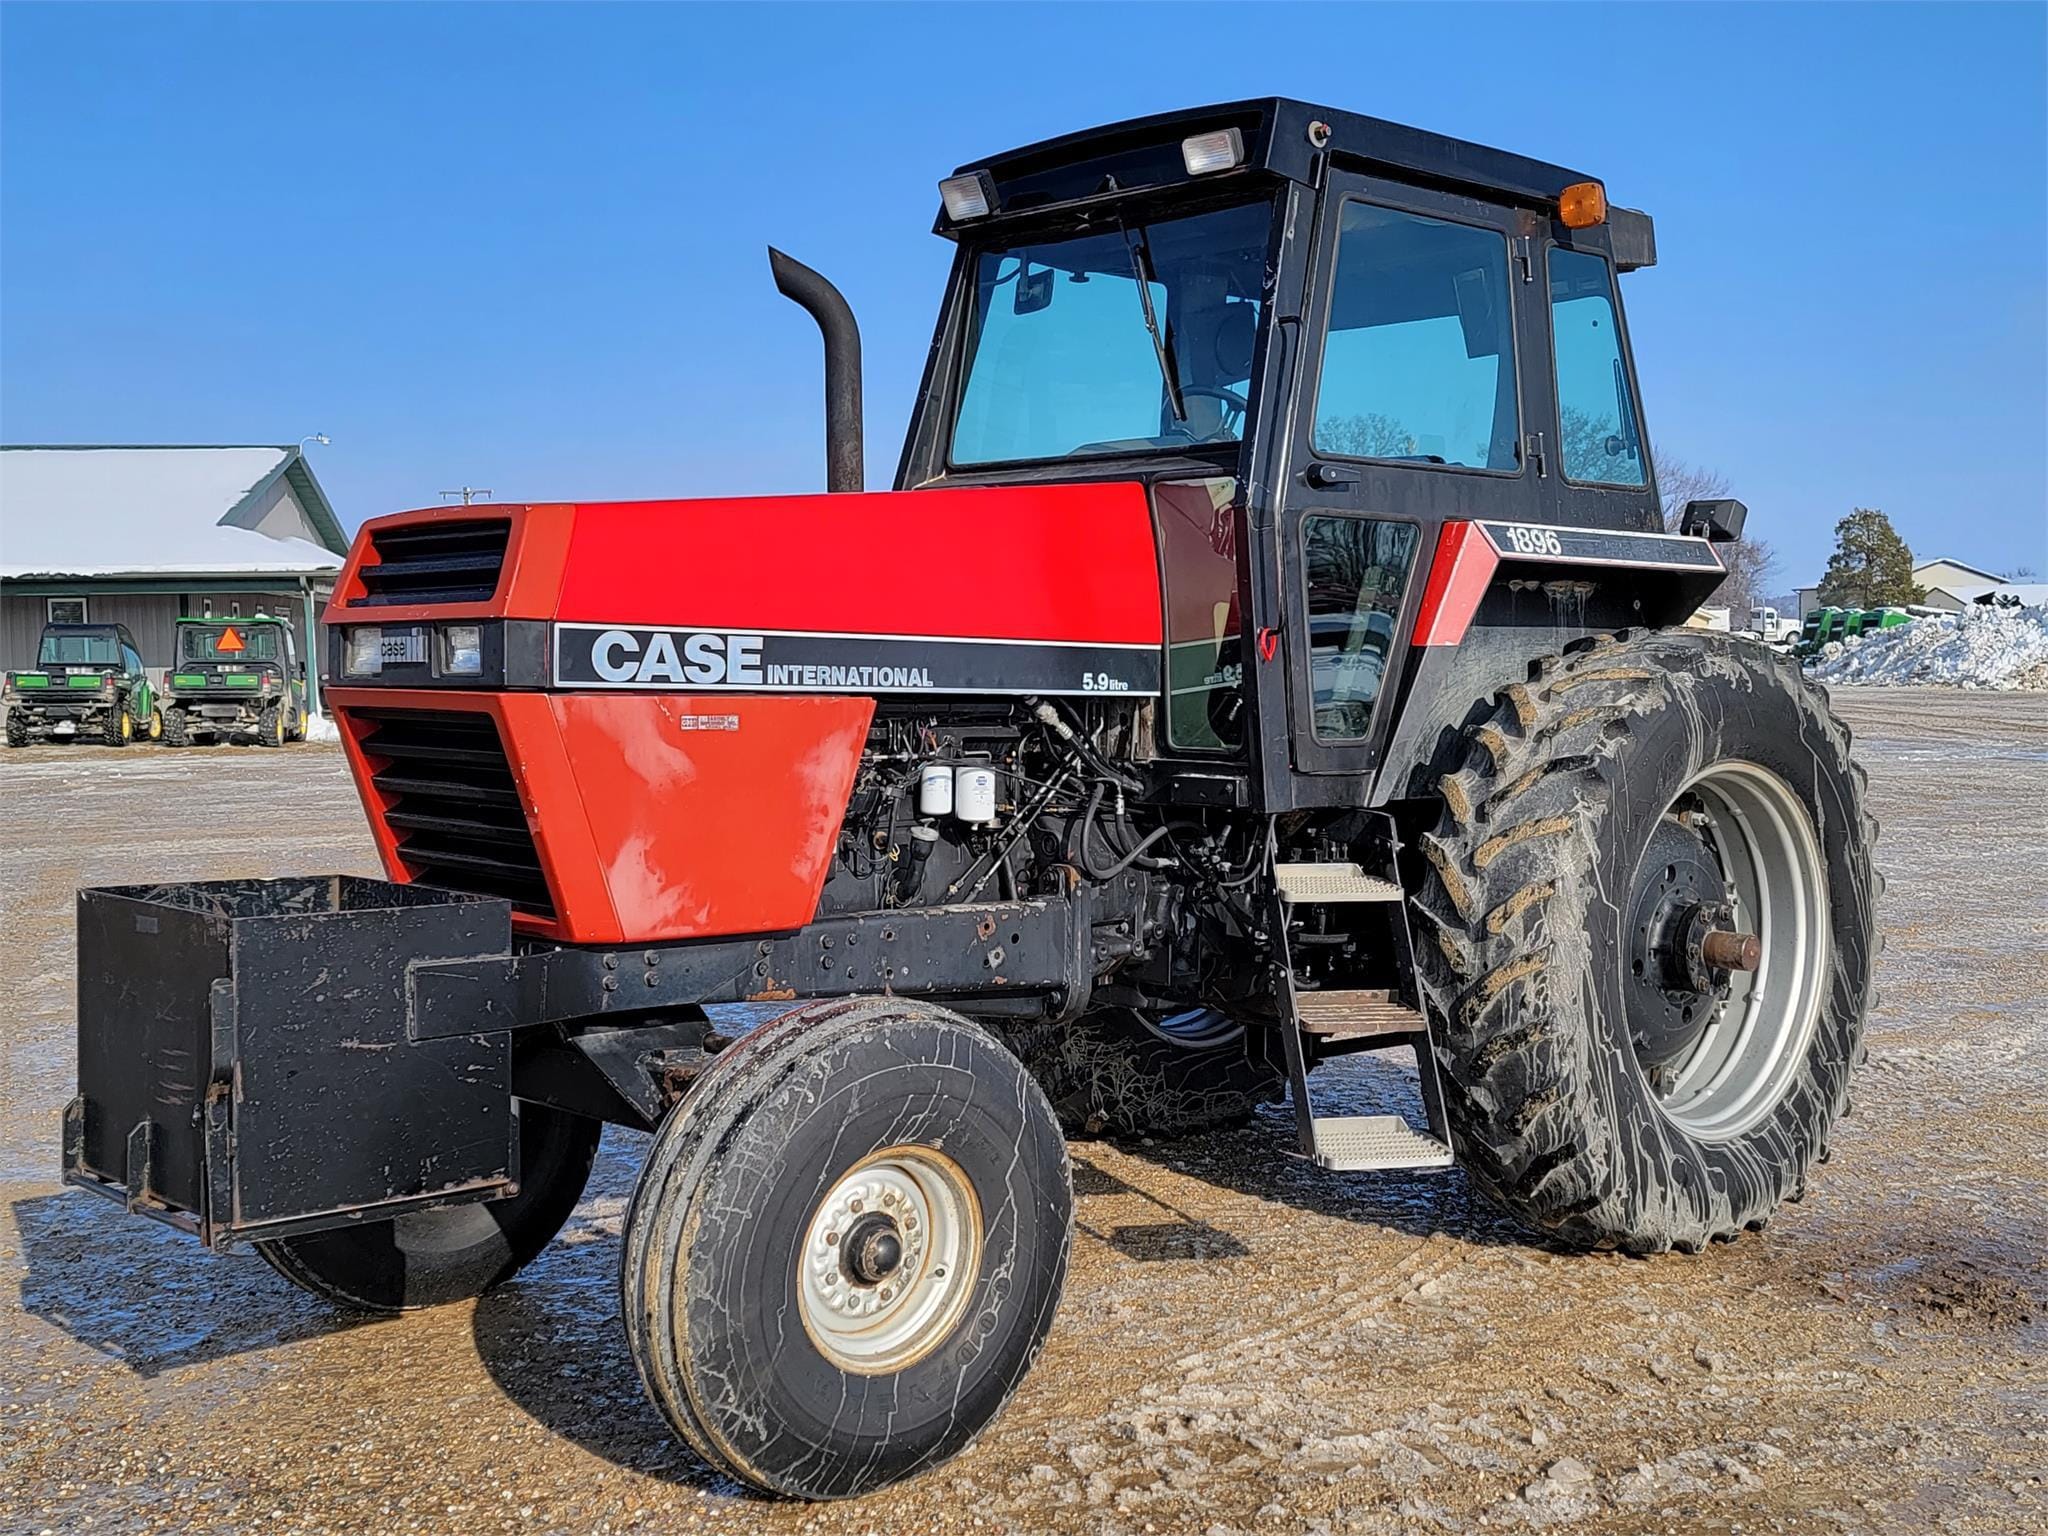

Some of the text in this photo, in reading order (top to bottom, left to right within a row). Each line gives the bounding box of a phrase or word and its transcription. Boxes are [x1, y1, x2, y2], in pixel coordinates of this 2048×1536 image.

[1506, 526, 1562, 555] 1896
[591, 630, 934, 688] CASE INTERNATIONAL
